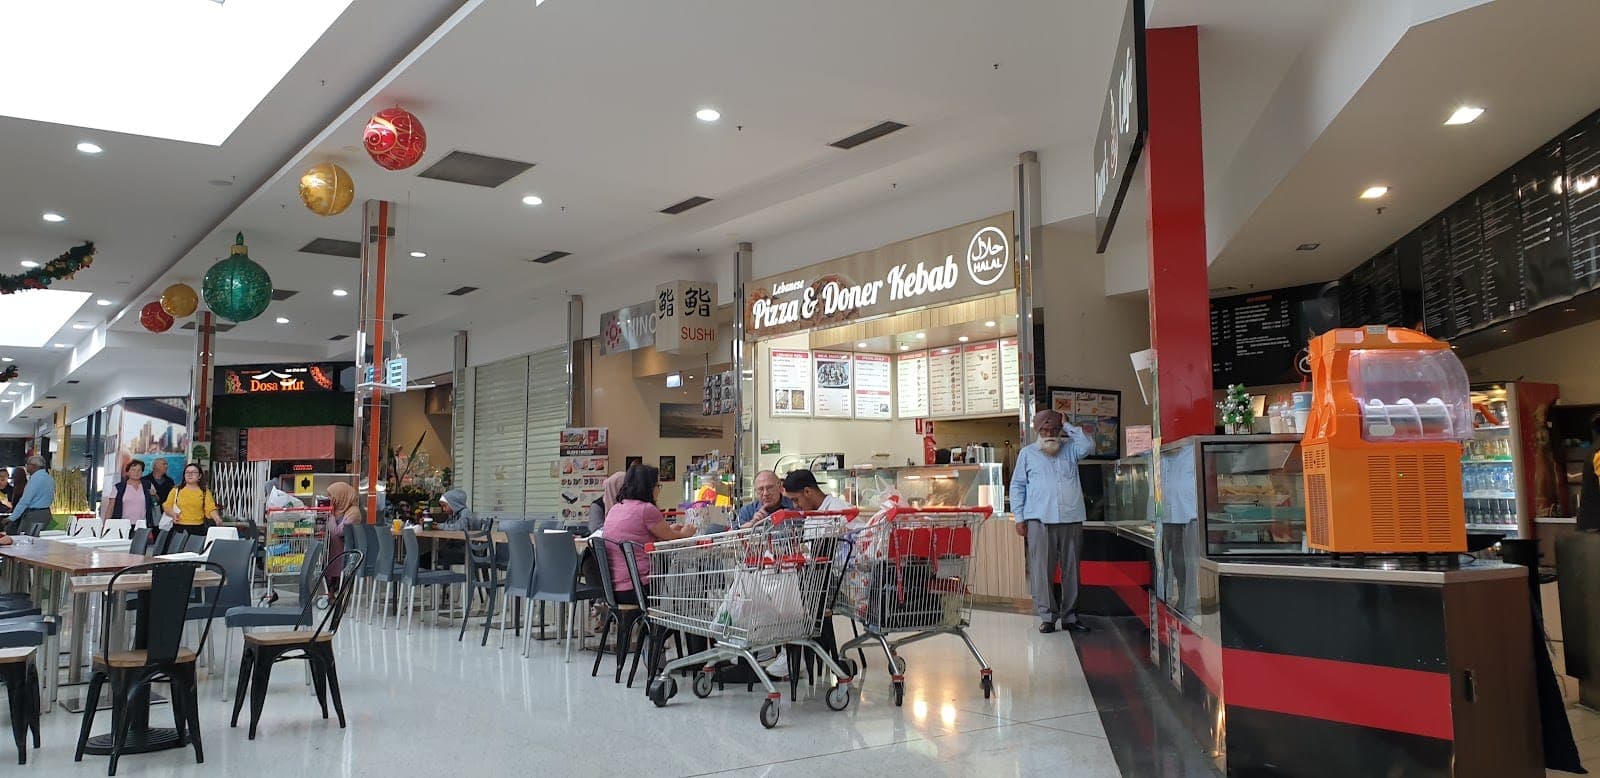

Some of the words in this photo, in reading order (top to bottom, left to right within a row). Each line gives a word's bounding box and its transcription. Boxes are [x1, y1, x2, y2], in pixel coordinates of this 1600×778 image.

[972, 236, 1004, 261] حلال
[973, 257, 1003, 273] HALAL
[753, 298, 799, 330] Pizza
[802, 287, 819, 319] &
[823, 280, 883, 315] Doner
[887, 254, 959, 301] Kebab
[772, 280, 805, 296] Lebanese
[684, 286, 711, 317] 鮨
[681, 326, 715, 341] SUSHI
[250, 379, 278, 392] Dosa
[280, 378, 305, 391] Hut
